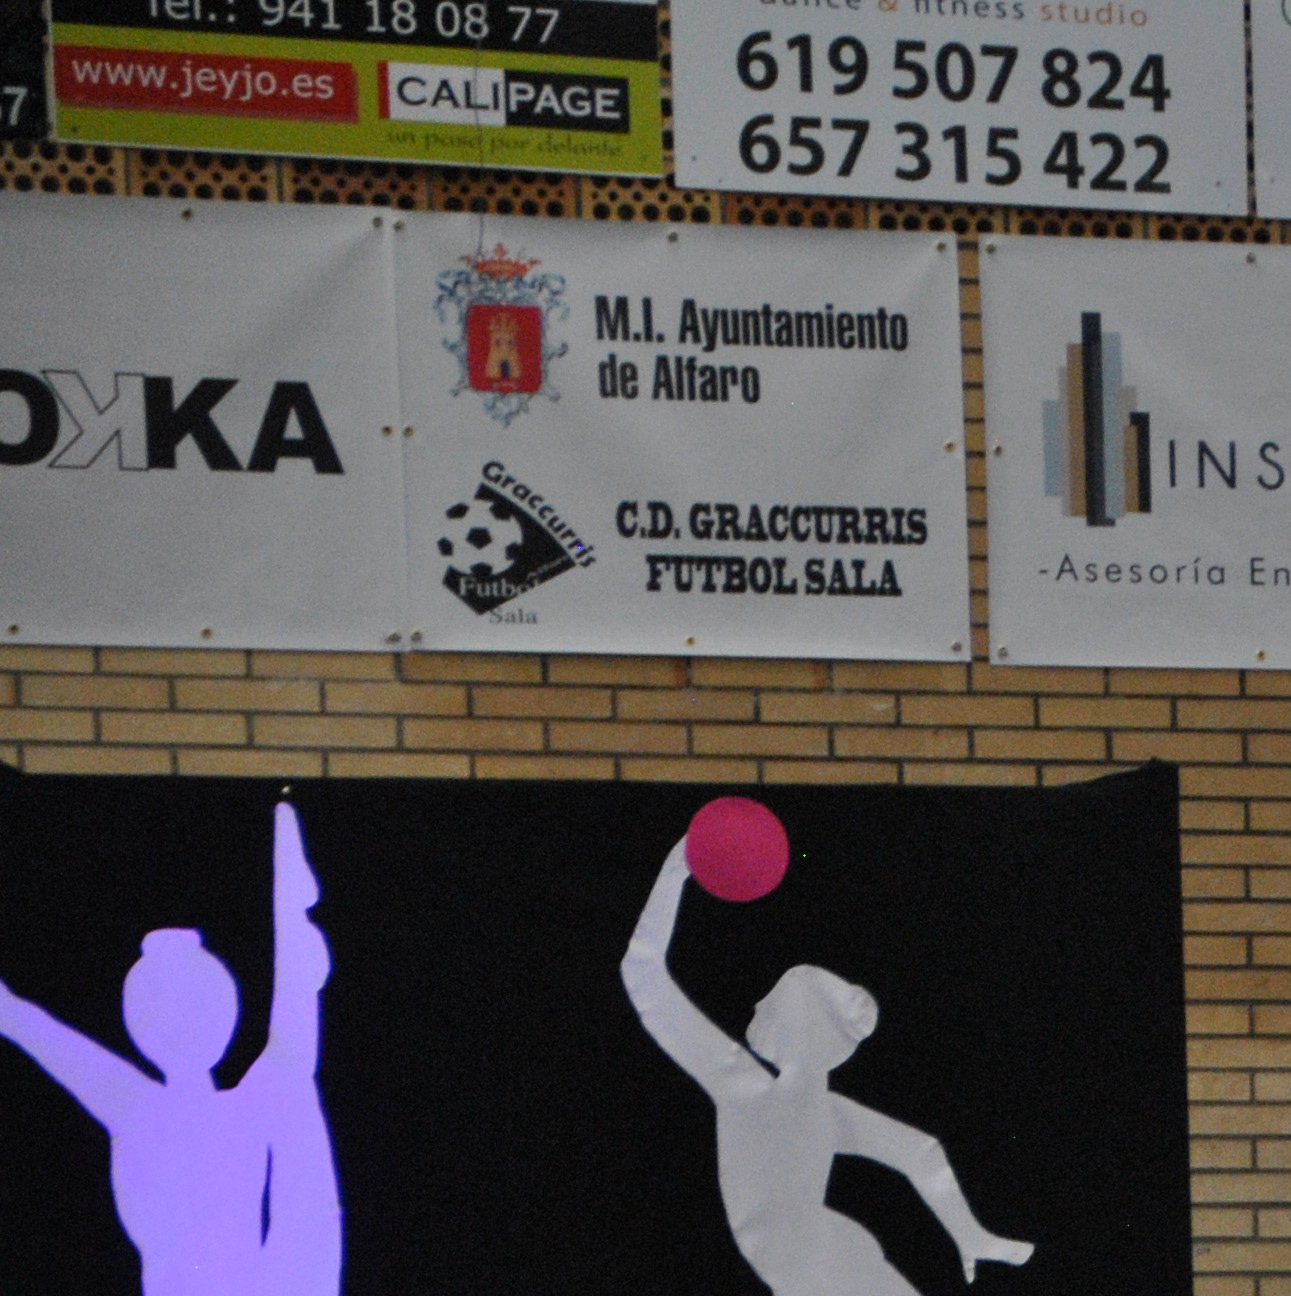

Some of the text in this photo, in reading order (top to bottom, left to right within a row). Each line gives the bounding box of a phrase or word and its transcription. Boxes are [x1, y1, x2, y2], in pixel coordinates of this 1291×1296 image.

[258, 0, 343, 30] 941
[366, 0, 418, 35] 18
[434, 0, 489, 40] 08
[508, 5, 561, 43] 77
[1040, 2, 1149, 27] studio
[70, 59, 336, 101] www.jeyjo.es
[736, 30, 1172, 113] 619 507 824
[397, 76, 622, 120] CALIPAGE
[738, 113, 1173, 194] 657 315 422
[595, 295, 909, 352] M.I. Ayuntamiento
[598, 353, 761, 404] de Alfaro
[481, 460, 597, 568] Graccurris
[615, 501, 929, 545] C.D. GRACCURRIS
[645, 555, 903, 597] FUTBOL SALA
[489, 606, 538, 625] Sala
